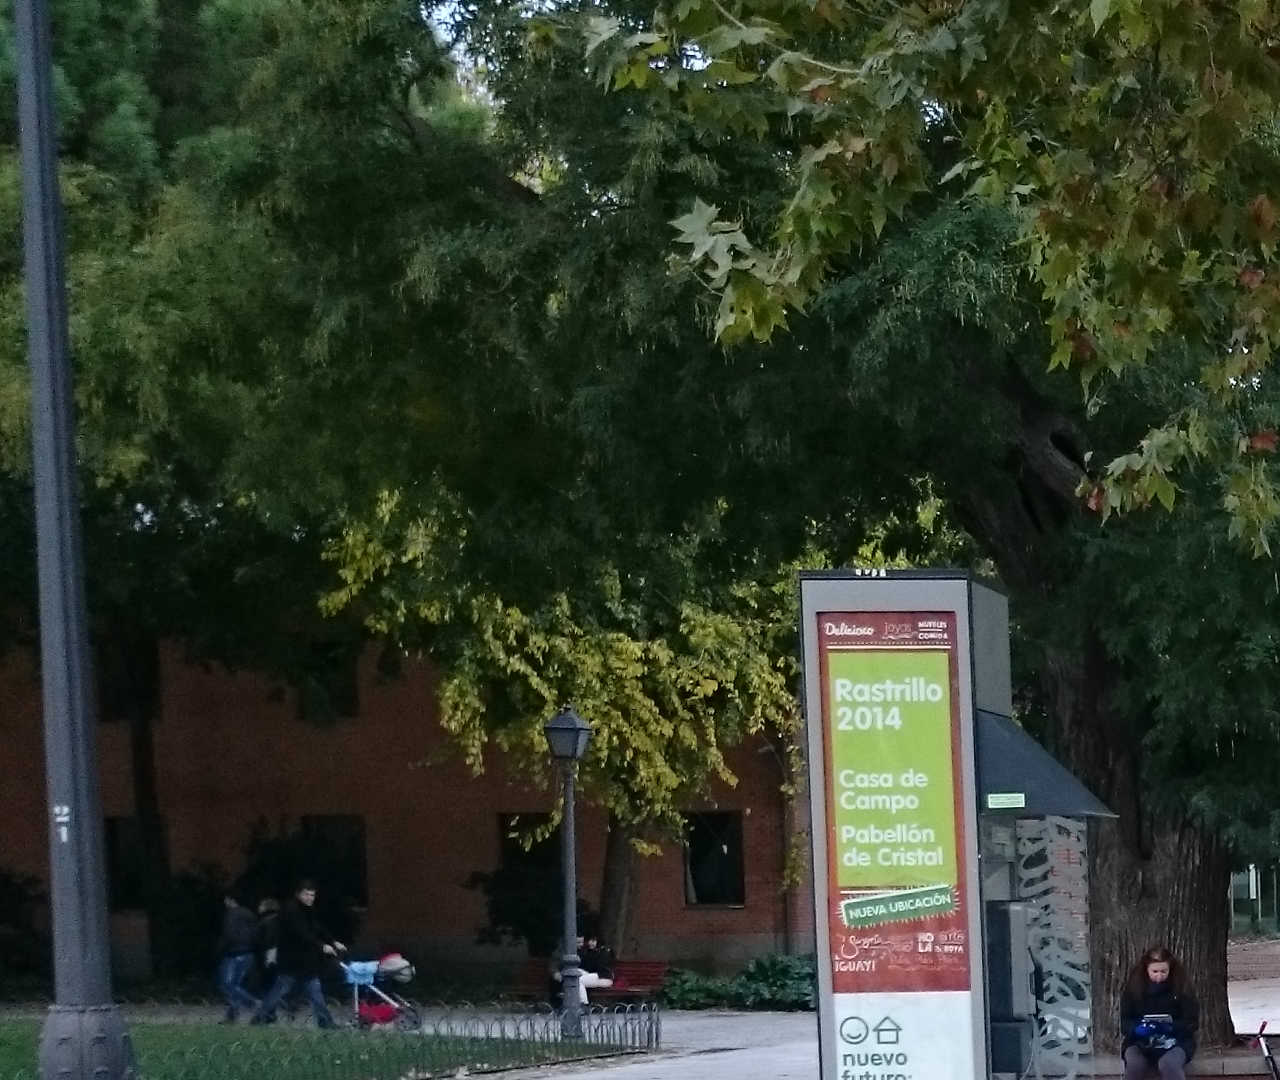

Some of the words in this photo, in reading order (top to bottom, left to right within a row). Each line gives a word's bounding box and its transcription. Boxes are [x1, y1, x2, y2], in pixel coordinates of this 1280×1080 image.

[835, 676, 943, 702] Rastrillo
[837, 706, 902, 730] 2014
[839, 770, 893, 788] Casa
[901, 768, 928, 788] de
[840, 791, 920, 814] Campo
[841, 824, 935, 844] Pabellón
[843, 847, 871, 867] de
[877, 847, 944, 866] Cristal
[849, 904, 887, 919] NUEVA
[889, 893, 951, 913] UBICACIÓN
[843, 1053, 908, 1067] nuevo
